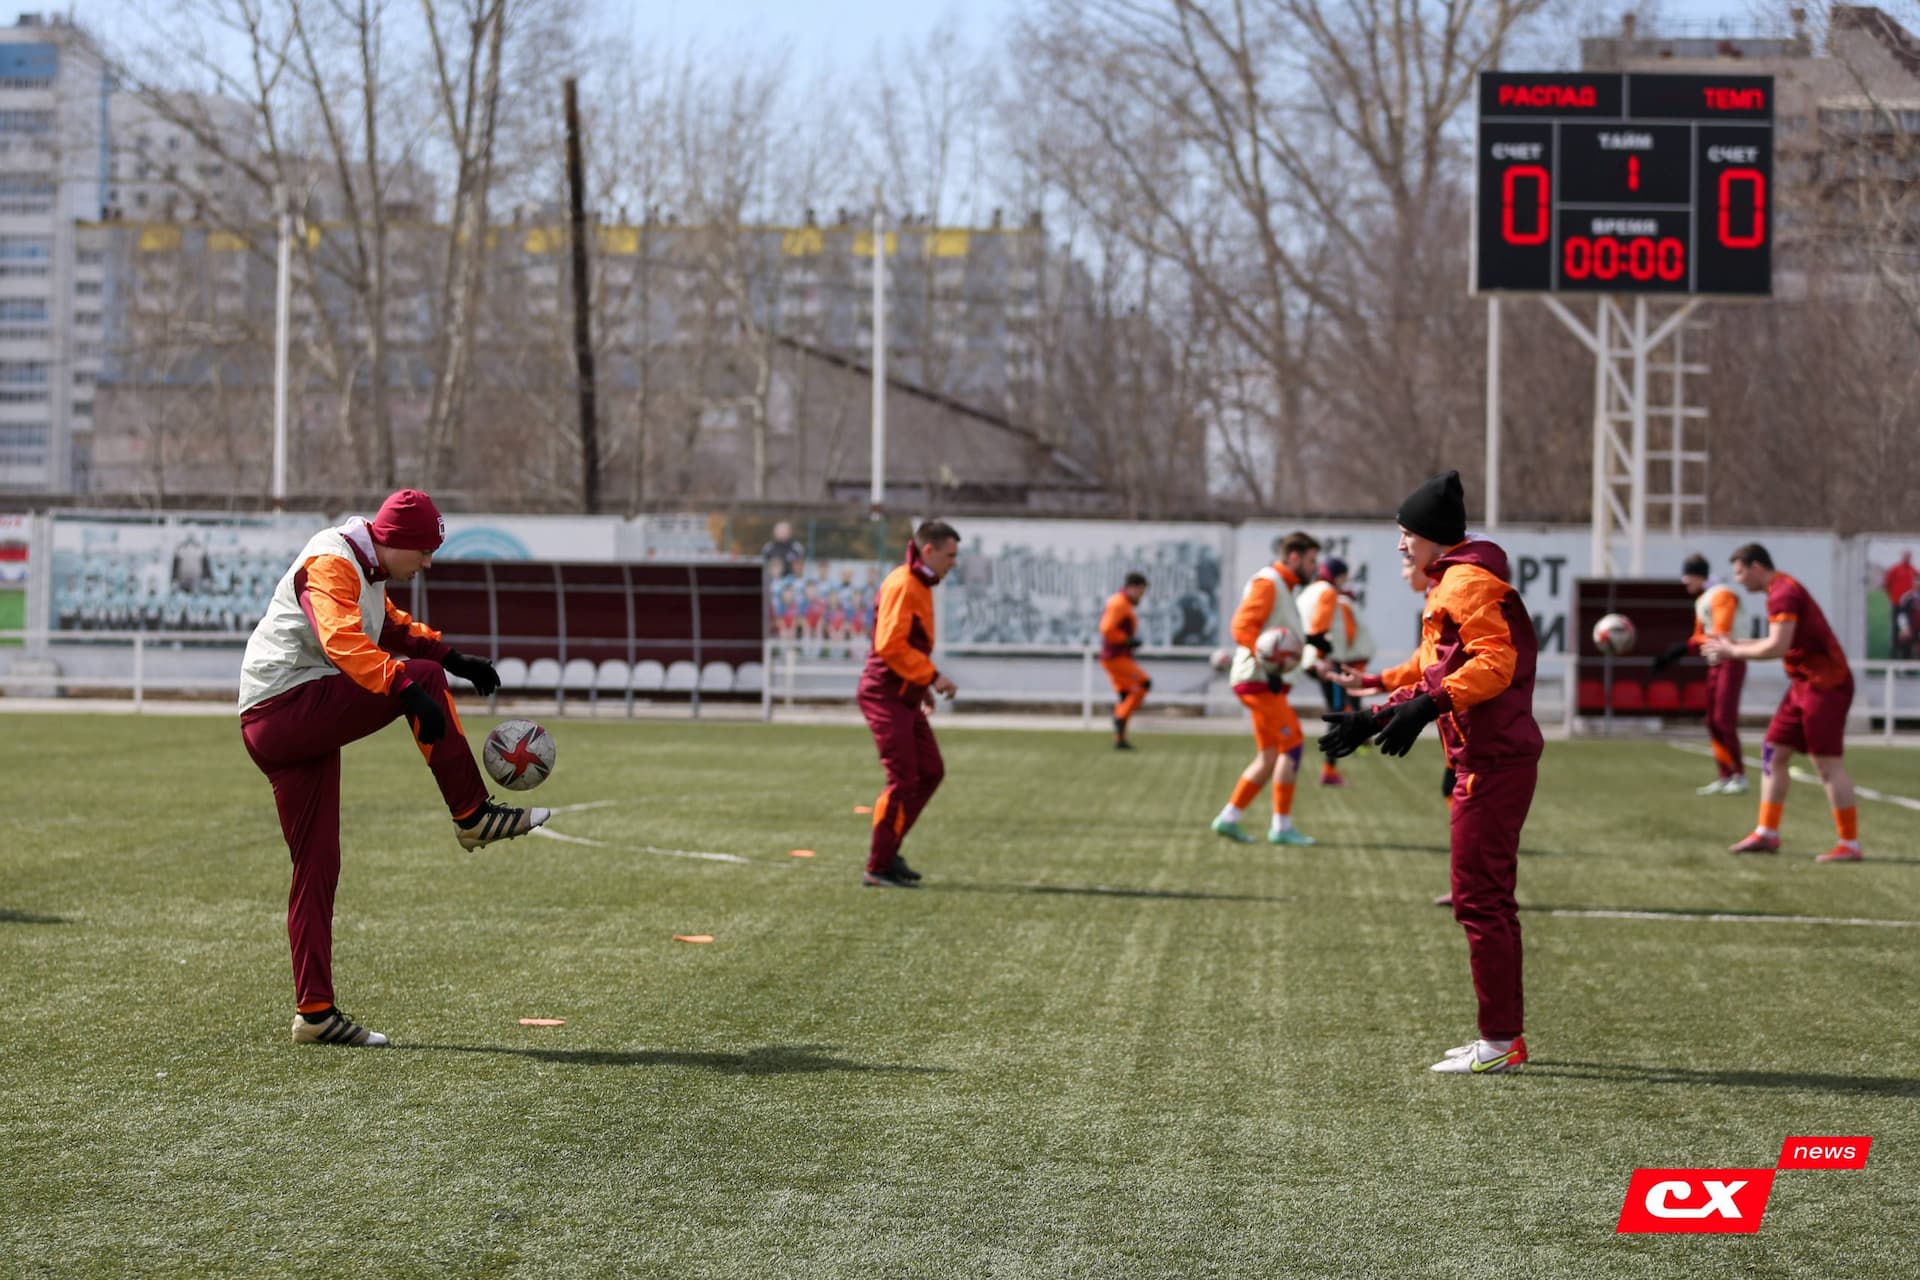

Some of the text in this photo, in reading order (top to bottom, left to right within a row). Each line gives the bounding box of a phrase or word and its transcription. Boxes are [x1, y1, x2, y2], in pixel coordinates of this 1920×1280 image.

[1498, 85, 1597, 107] РАСПАД
[1703, 87, 1765, 110] ТЕМП
[1491, 142, 1543, 161] СЧЕТ
[1597, 132, 1654, 150] ТАЙМ
[1707, 145, 1760, 163] СЧЕТ
[1627, 155, 1641, 191] 1
[1502, 165, 1550, 246] 0
[1717, 168, 1766, 249] 0
[1563, 236, 1685, 281] 00:00
